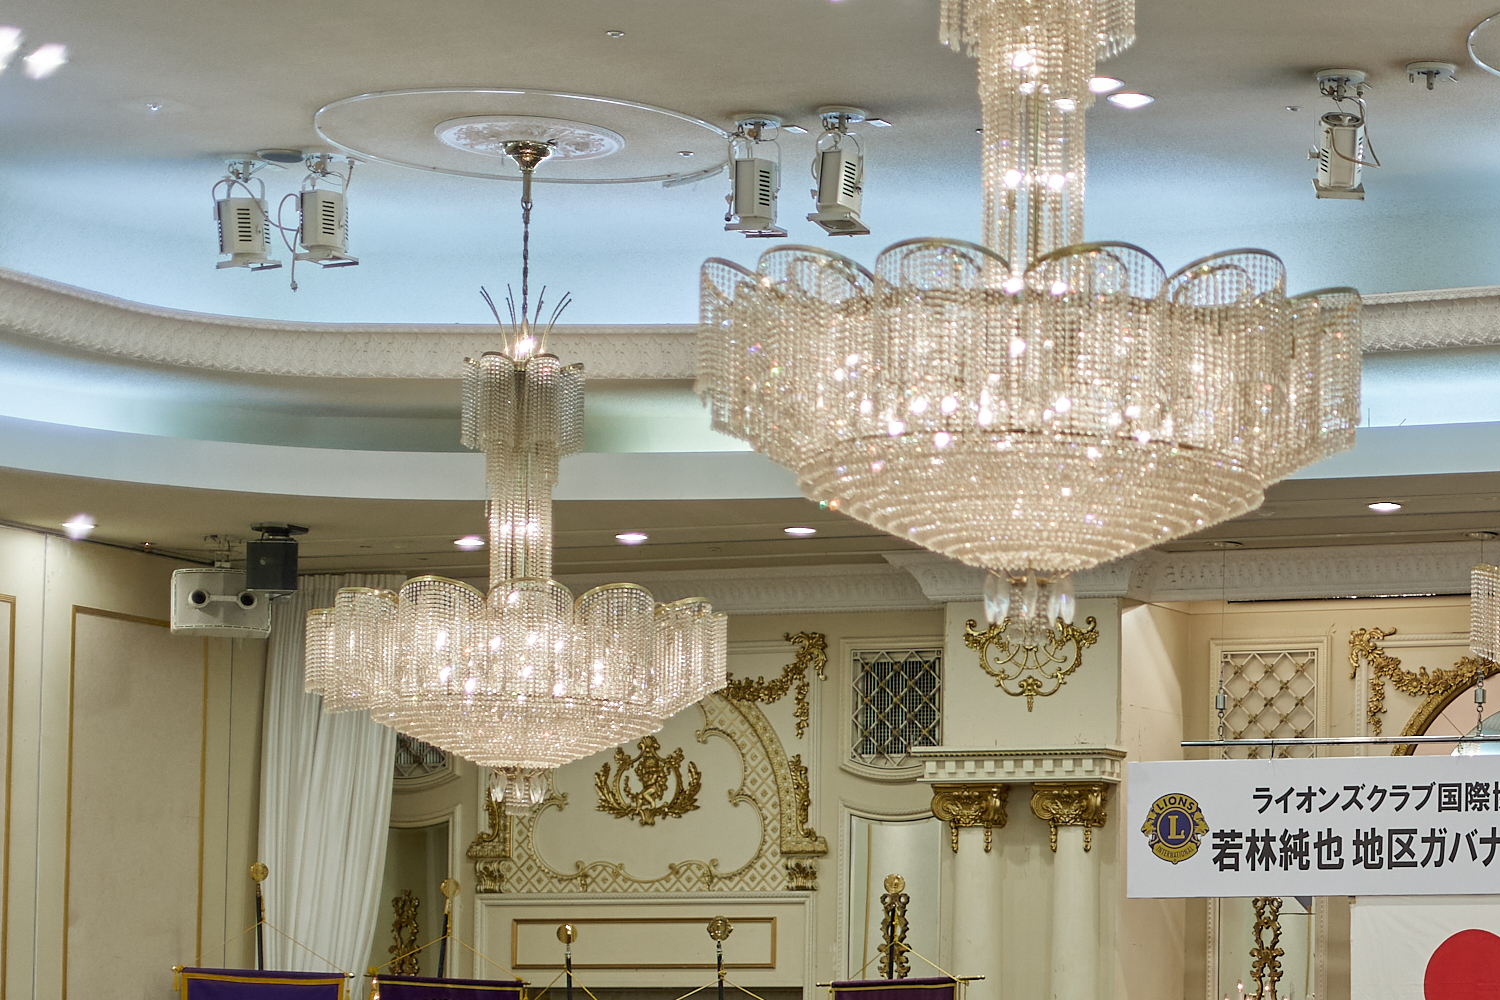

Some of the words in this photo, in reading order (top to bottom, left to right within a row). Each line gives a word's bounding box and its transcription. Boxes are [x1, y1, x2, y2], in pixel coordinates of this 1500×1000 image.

[1156, 796, 1195, 811] LIONS
[1168, 815, 1185, 839] L
[1156, 846, 1194, 858] INTERNATIONAL
[1212, 828, 1344, 871] 若林純也
